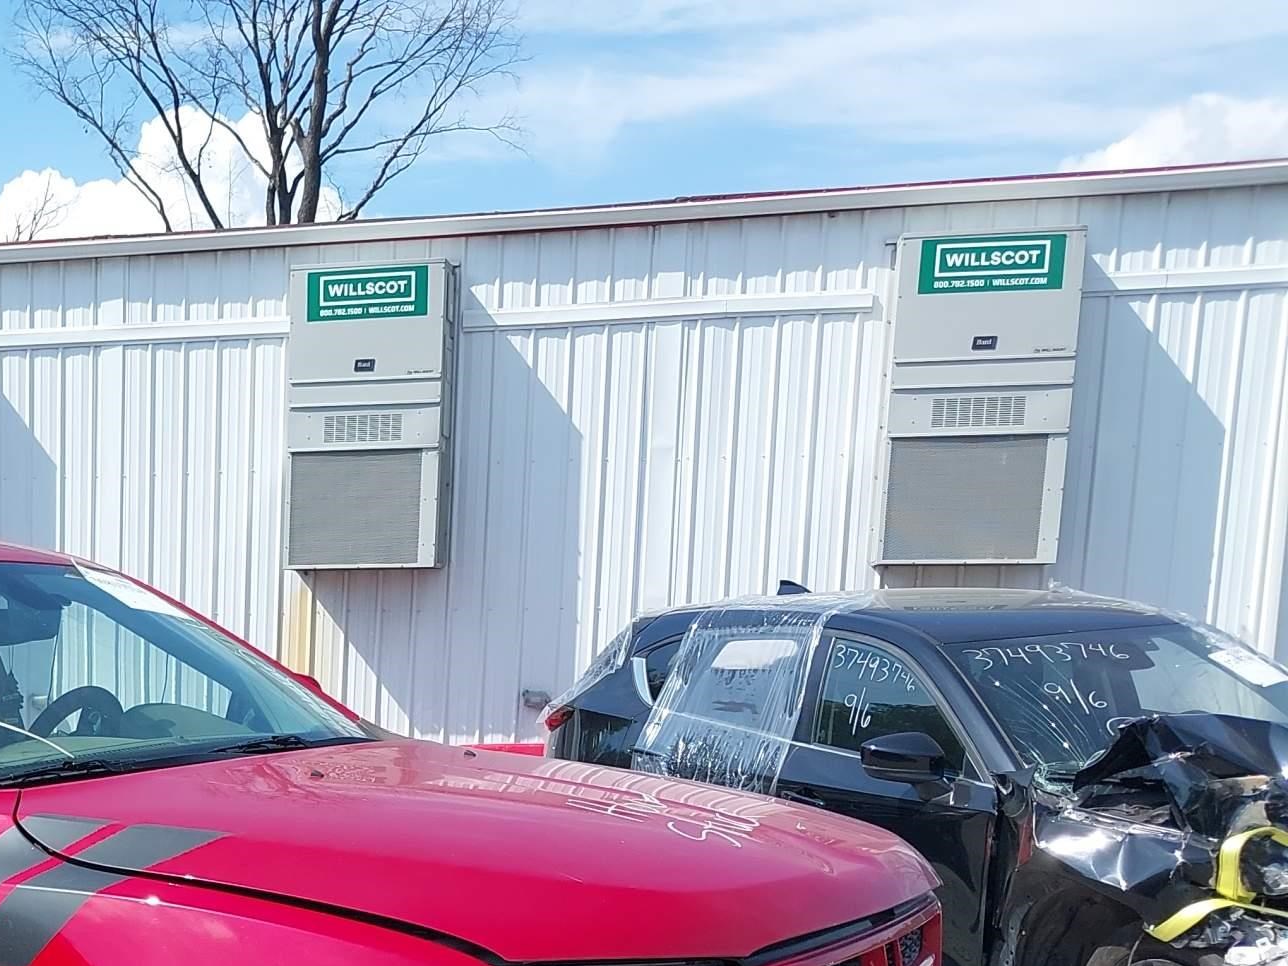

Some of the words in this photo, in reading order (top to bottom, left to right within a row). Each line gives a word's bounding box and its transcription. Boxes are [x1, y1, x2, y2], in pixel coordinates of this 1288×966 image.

[945, 249, 1041, 267] WILLSCOT
[328, 280, 408, 297] WILLSCOT
[991, 276, 1048, 287] WILLSCOT.COM
[834, 644, 916, 692] 37493746
[962, 642, 1130, 671] 37493746
[1043, 678, 1108, 714] 9/6
[844, 687, 872, 736] 9/6
